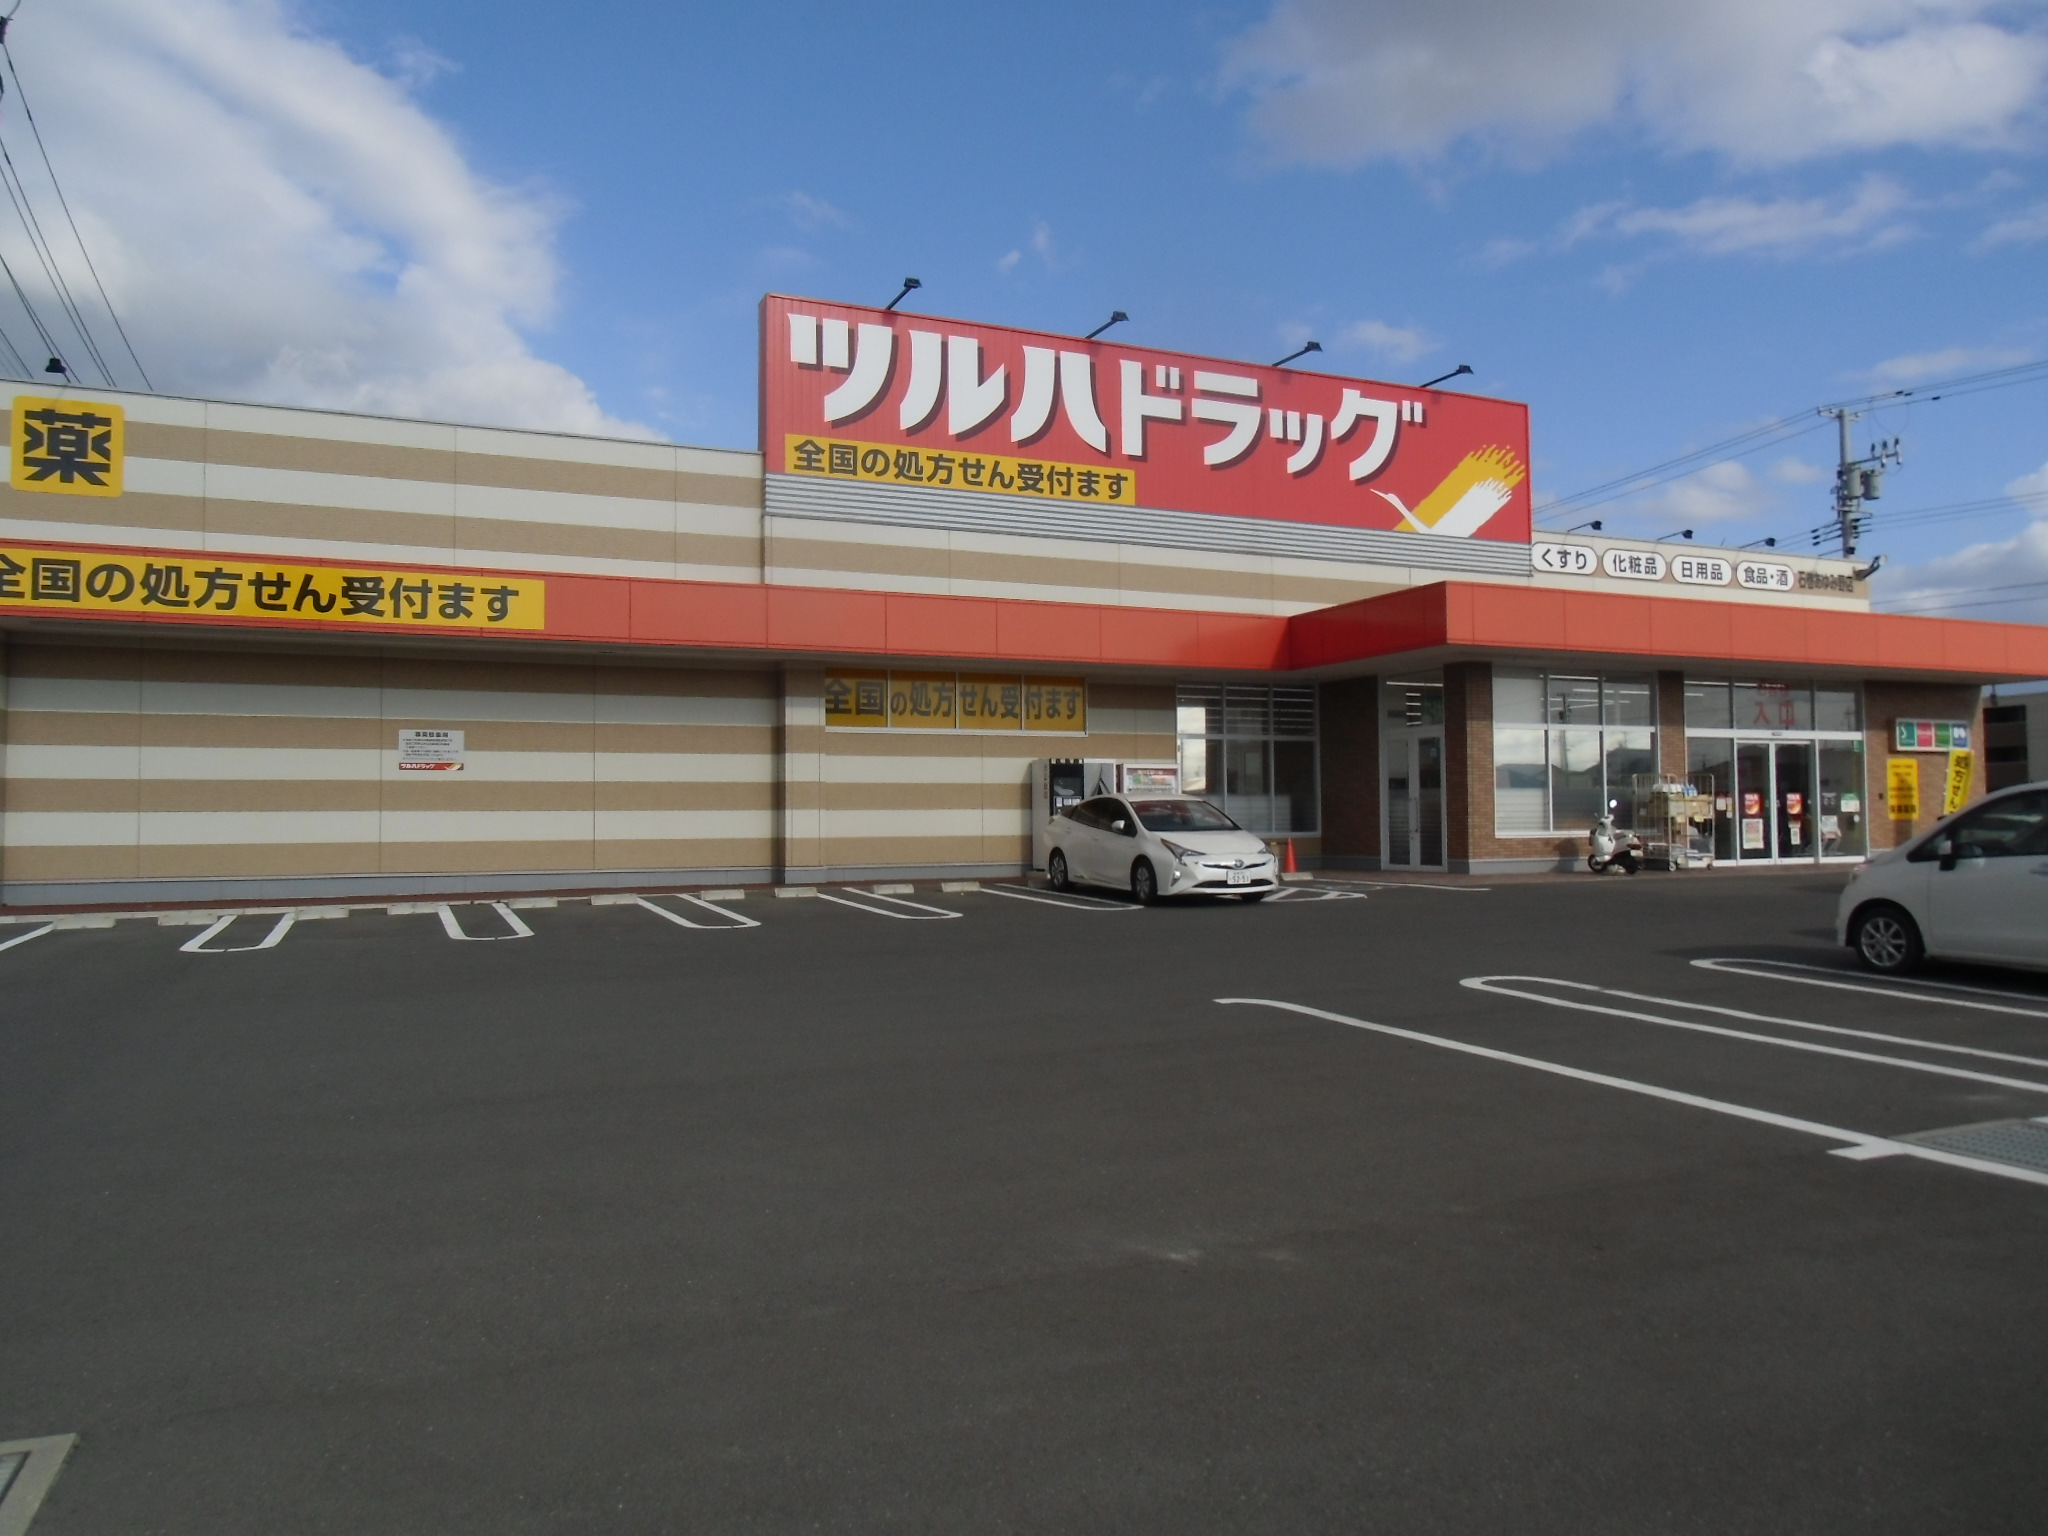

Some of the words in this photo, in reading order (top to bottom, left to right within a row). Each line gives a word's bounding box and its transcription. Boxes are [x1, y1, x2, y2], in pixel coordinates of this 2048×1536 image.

[787, 313, 1423, 482] ツルハドラッグ
[23, 408, 112, 487] 薬
[793, 439, 1128, 500] 全国の処方せん受付ます
[1541, 548, 1587, 570] くすり
[1613, 554, 1657, 576] 化粧品
[1681, 561, 1723, 581] 日用品
[1743, 566, 1788, 586] 食品・酒
[824, 678, 1081, 720] 全国の処方せん受付ます
[1753, 701, 1796, 727] 入口
